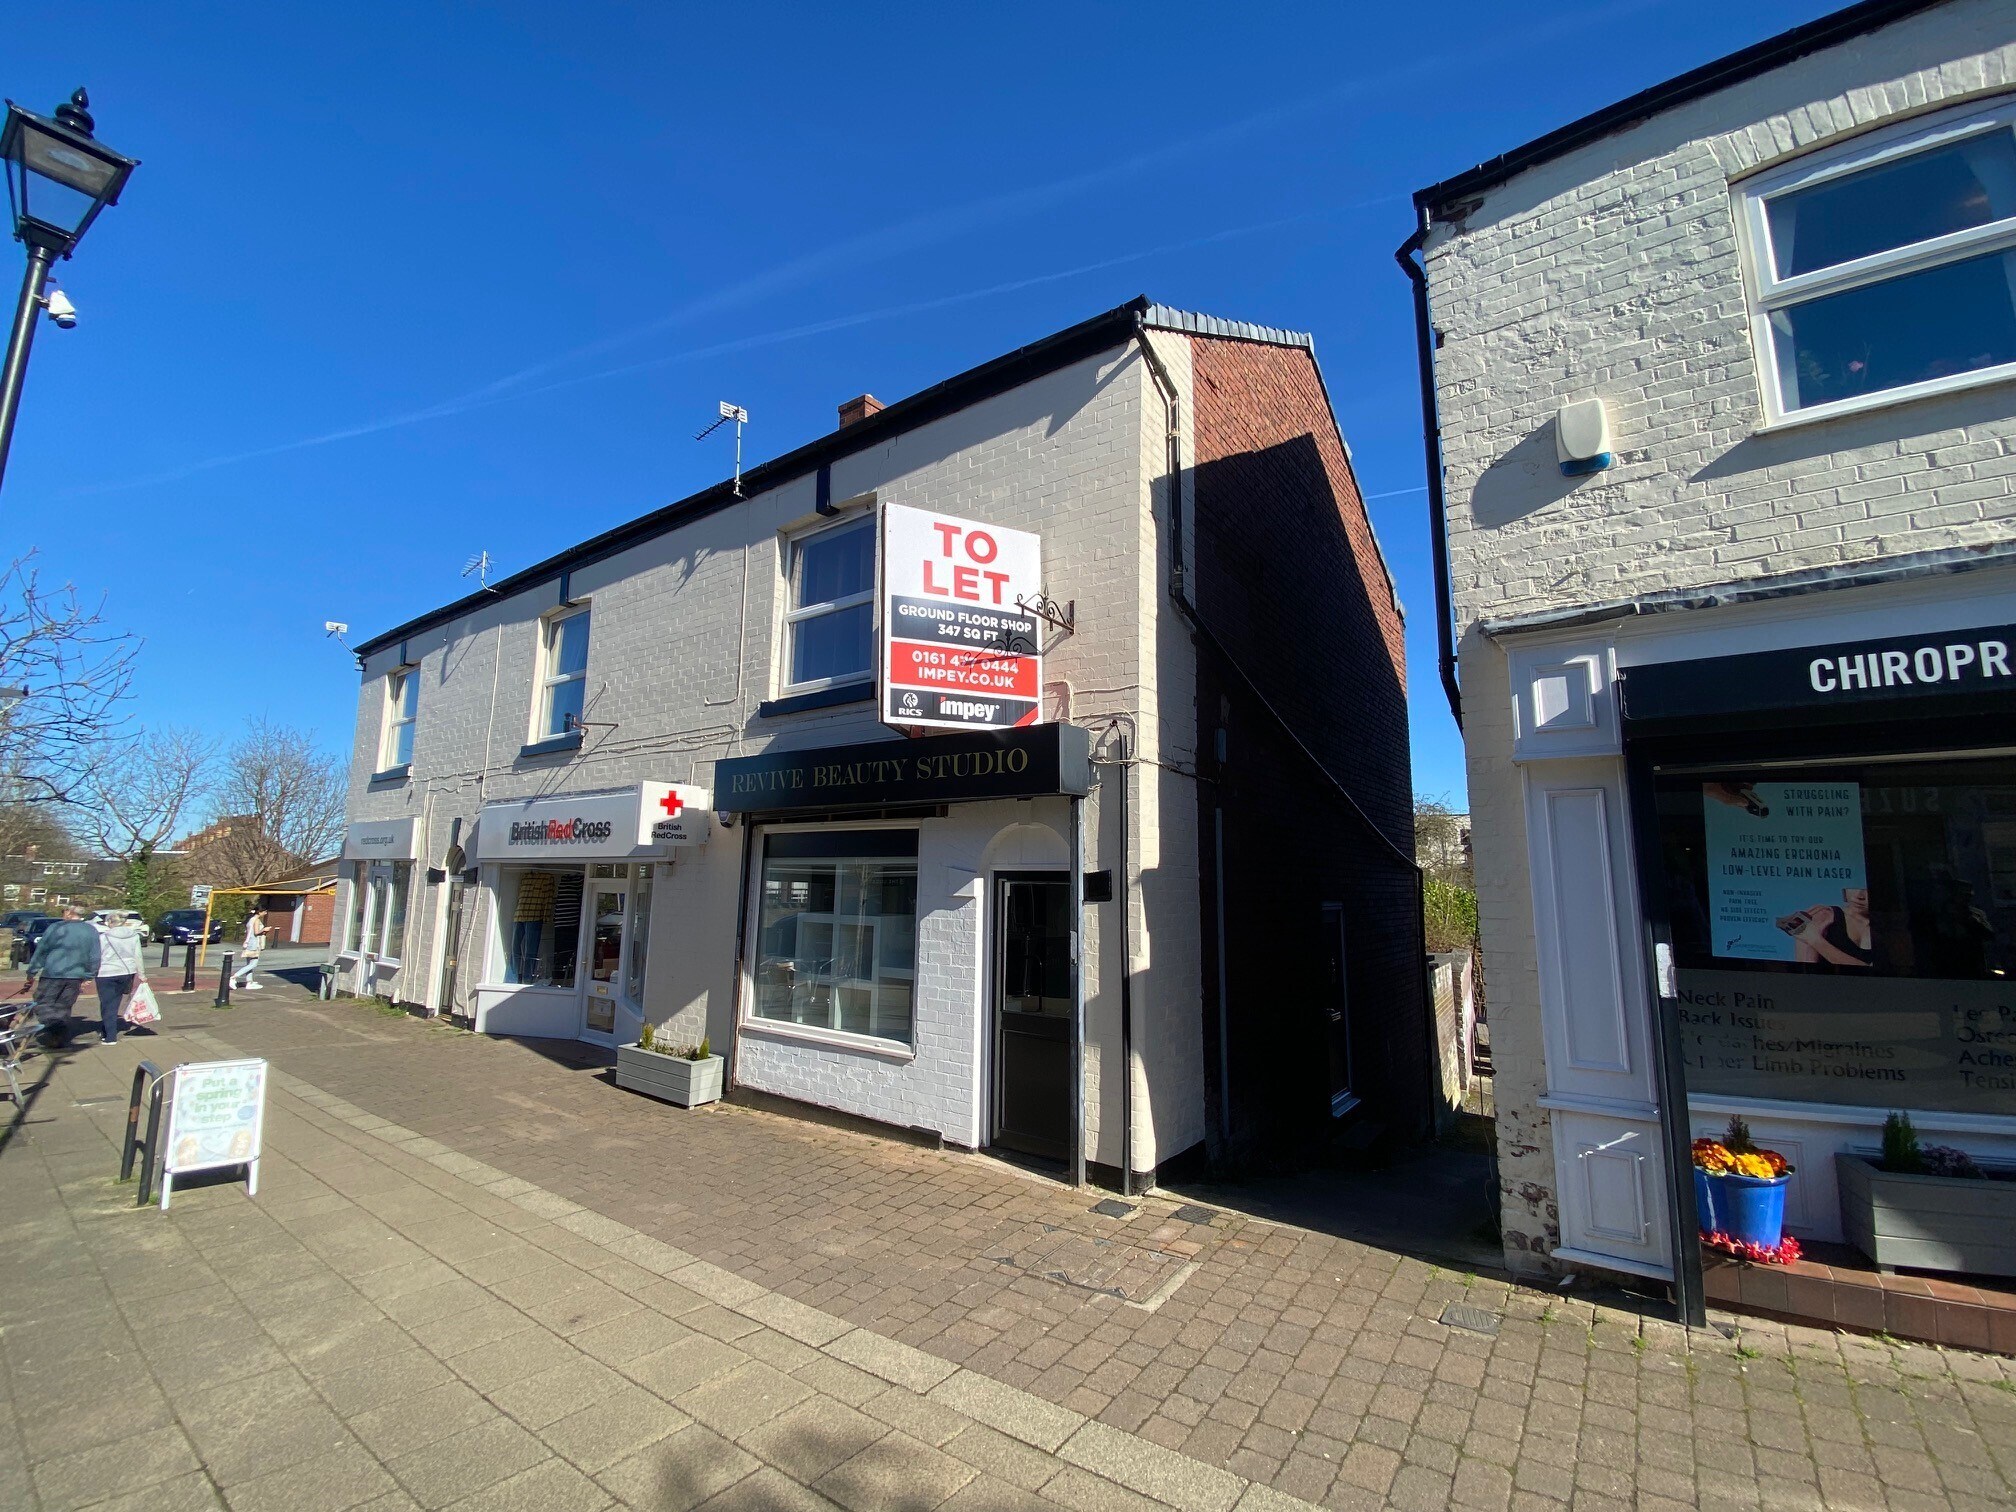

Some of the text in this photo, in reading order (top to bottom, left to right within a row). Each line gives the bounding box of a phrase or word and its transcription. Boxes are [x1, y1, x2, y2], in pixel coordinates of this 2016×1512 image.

[934, 522, 998, 564] TO
[923, 560, 1010, 605] LET
[898, 604, 1032, 633] GROUND FLOOR SHOP
[938, 624, 999, 641] 347 SQ FT
[912, 650, 946, 666] 0161
[980, 659, 1019, 674] 0444
[1809, 640, 2012, 693] CHIROPR
[918, 667, 1015, 688] IMPEY.CO.UK
[898, 707, 924, 717] RICS
[939, 696, 998, 722] impey
[732, 748, 1029, 793] REVIVE BEAUTY STUDIO
[1783, 789, 1850, 800] STRUGGLING
[1785, 806, 1850, 817] WITH PAIN?
[657, 822, 682, 831] British
[651, 831, 687, 840] RedCross
[1757, 835, 1775, 843] TIME
[1779, 835, 1788, 843] TO
[1791, 835, 1805, 844] TRY
[1808, 836, 1824, 844] OUR
[1731, 847, 1841, 860] AMAZING ERCHONIA
[1722, 864, 1852, 879] LOW-LEVEL PAIN LASER
[1677, 989, 1775, 1009] Neck Pain
[1679, 1009, 1722, 1025] Back
[1752, 1055, 1802, 1074] Limb
[1810, 1058, 1906, 1081] Problems
[202, 1077, 226, 1088] Put
[195, 1088, 242, 1102] spring
[211, 1101, 242, 1112] your
[200, 1114, 231, 1124] step
